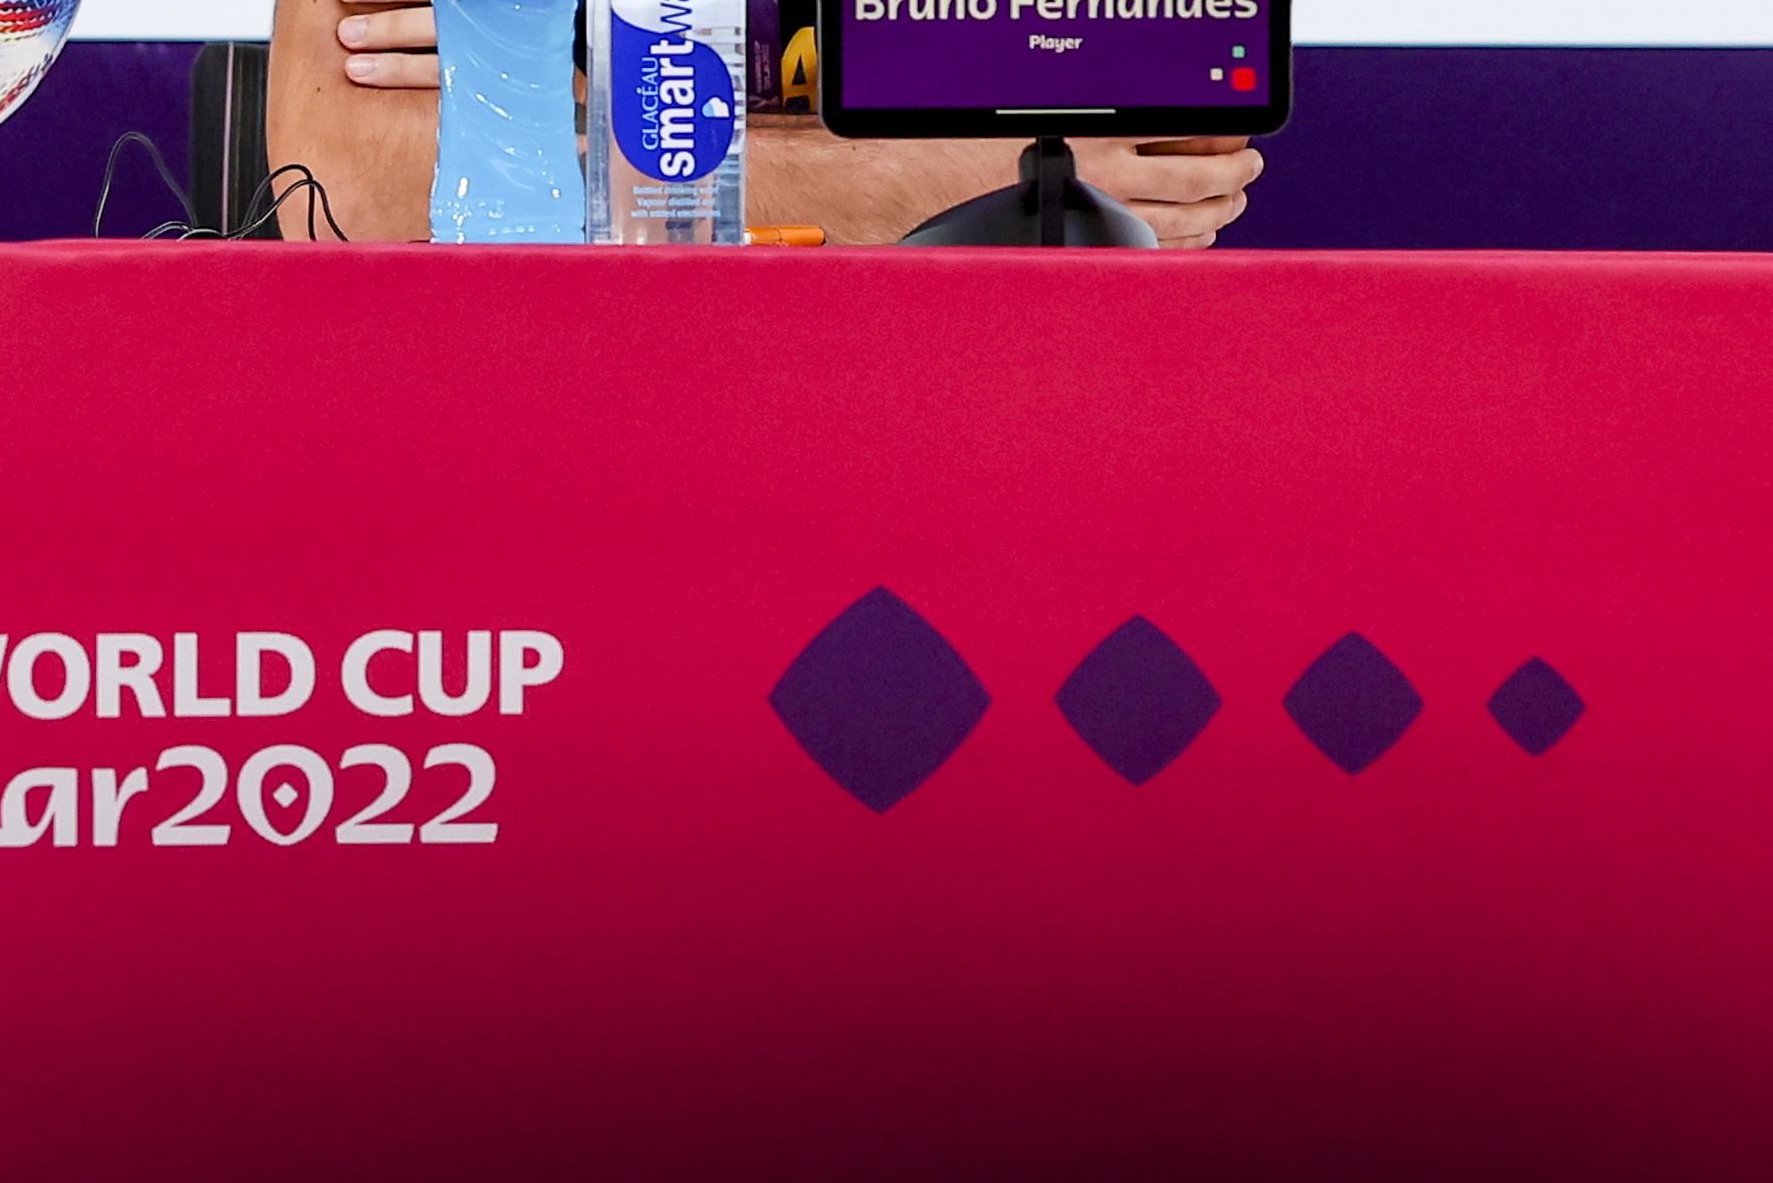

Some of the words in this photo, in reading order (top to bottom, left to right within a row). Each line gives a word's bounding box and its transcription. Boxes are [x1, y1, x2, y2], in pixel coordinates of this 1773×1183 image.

[1029, 34, 1083, 53] Player
[637, 57, 660, 150] GLACÉAU
[341, 629, 564, 716] CUP
